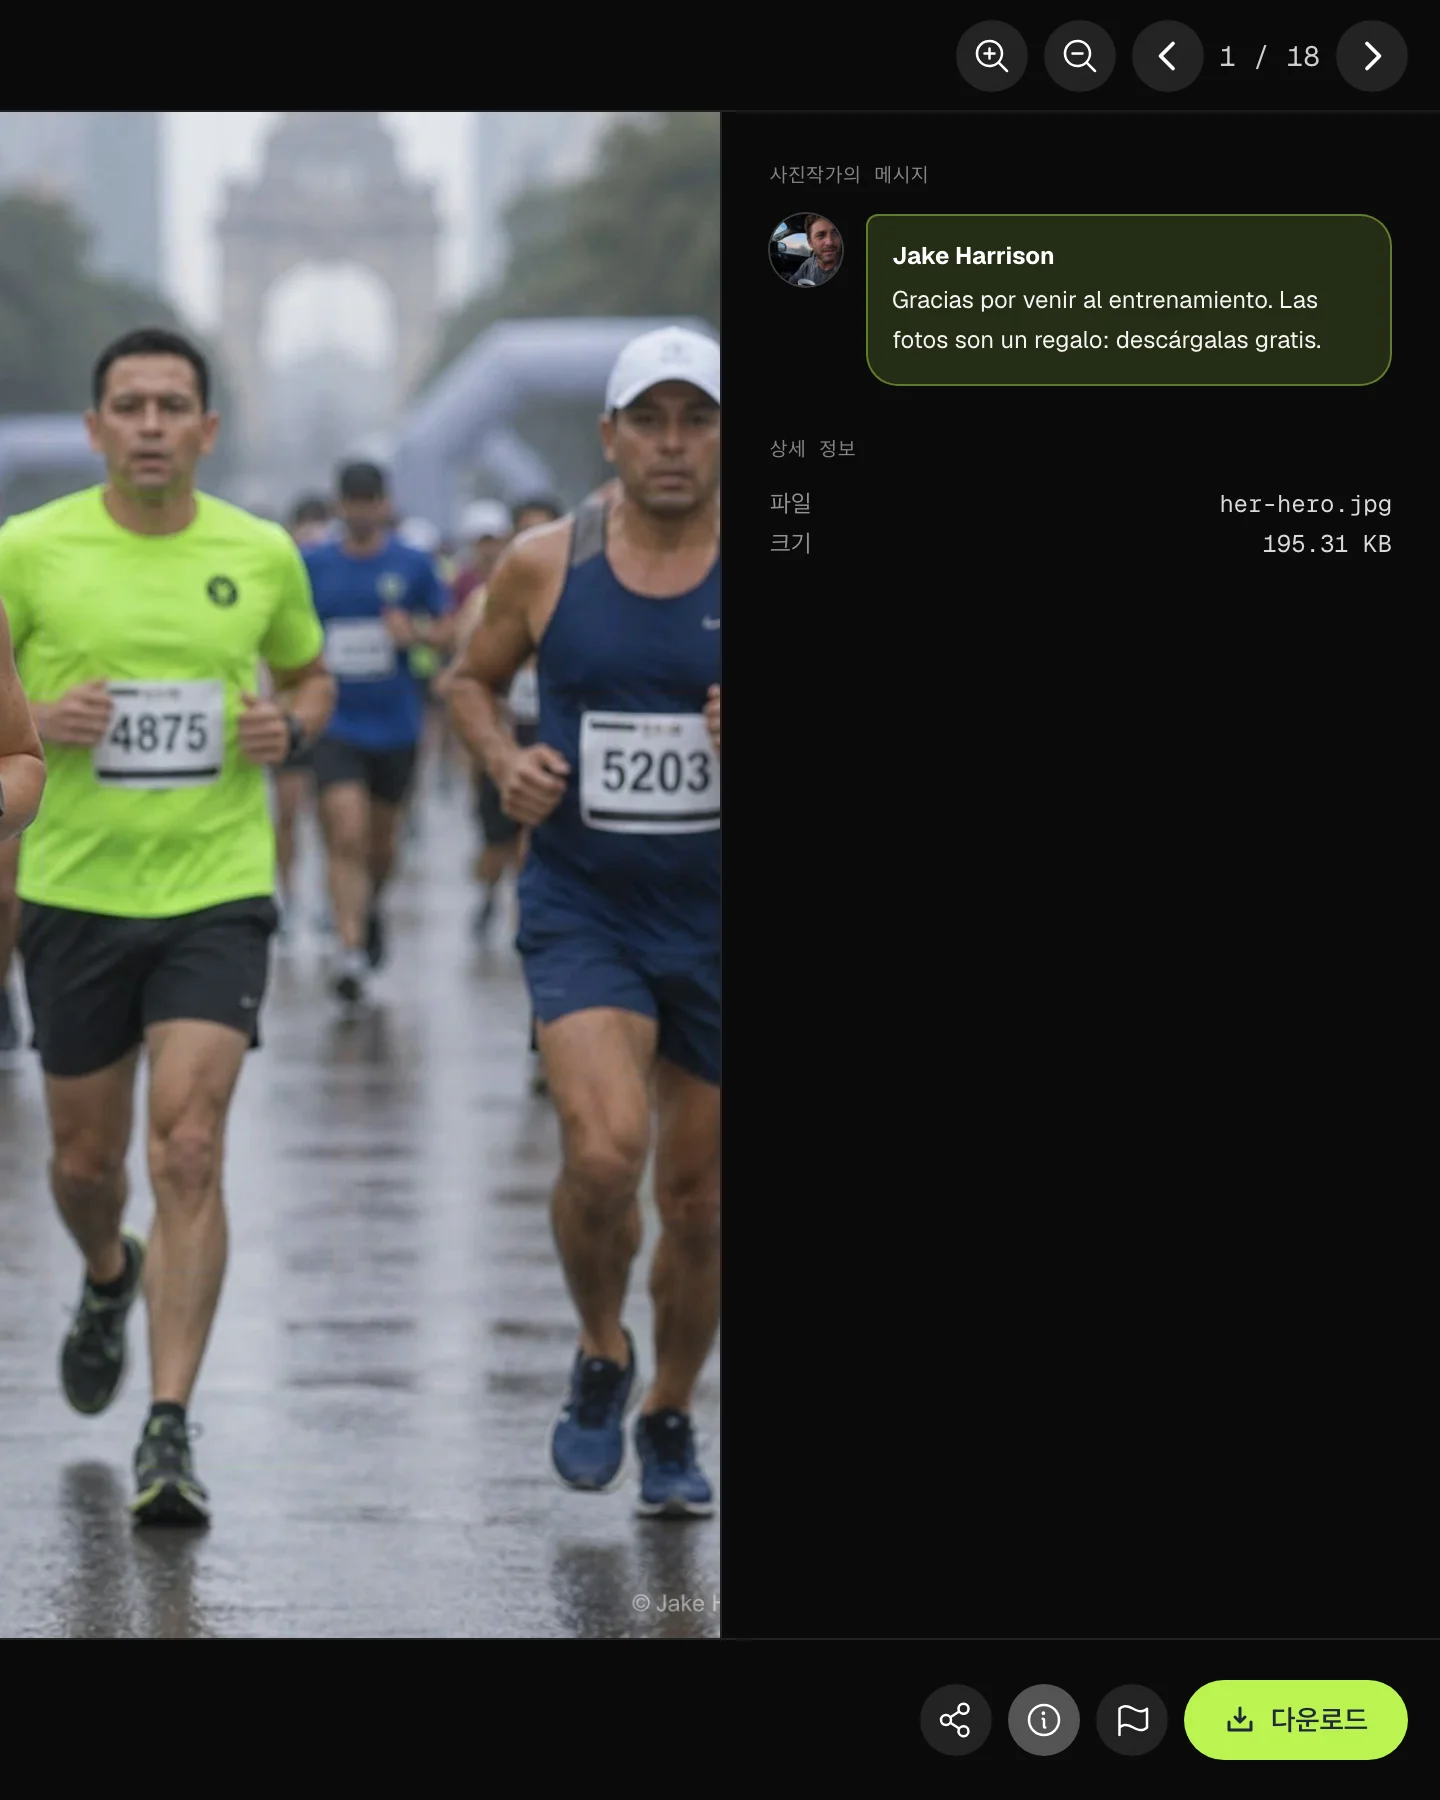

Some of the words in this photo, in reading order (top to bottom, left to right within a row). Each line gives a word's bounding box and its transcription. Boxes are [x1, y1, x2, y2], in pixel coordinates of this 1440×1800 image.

[1220, 45, 1236, 68] 1
[1287, 45, 1320, 68] 18
[770, 165, 860, 185] 사진작가의
[875, 165, 928, 185] 메시지
[892, 246, 950, 265] Jake
[956, 246, 1055, 265] Harrison
[892, 289, 974, 309] Gracias
[981, 294, 1017, 313] por
[1023, 290, 1077, 309] venir
[1083, 290, 1103, 309] al
[1109, 290, 1273, 309] entrenamiento.
[1280, 290, 1318, 309] Las
[892, 330, 948, 349] fotos
[955, 334, 993, 349] son
[1001, 334, 1028, 349] un
[1035, 330, 1109, 353] regalo:
[1116, 329, 1249, 353] descárgalas
[1255, 330, 1321, 353] gratis.
[770, 439, 805, 459] 상세
[819, 439, 856, 459] 정보
[770, 492, 811, 515] 파일
[1220, 494, 1391, 517] her-hero.jpg
[770, 532, 810, 555] 크기
[1263, 533, 1348, 553] 195.31
[1364, 534, 1392, 553] KB
[110, 711, 208, 755] 4875
[602, 748, 712, 793] 5203
[1272, 1706, 1368, 1733] 다운로드
